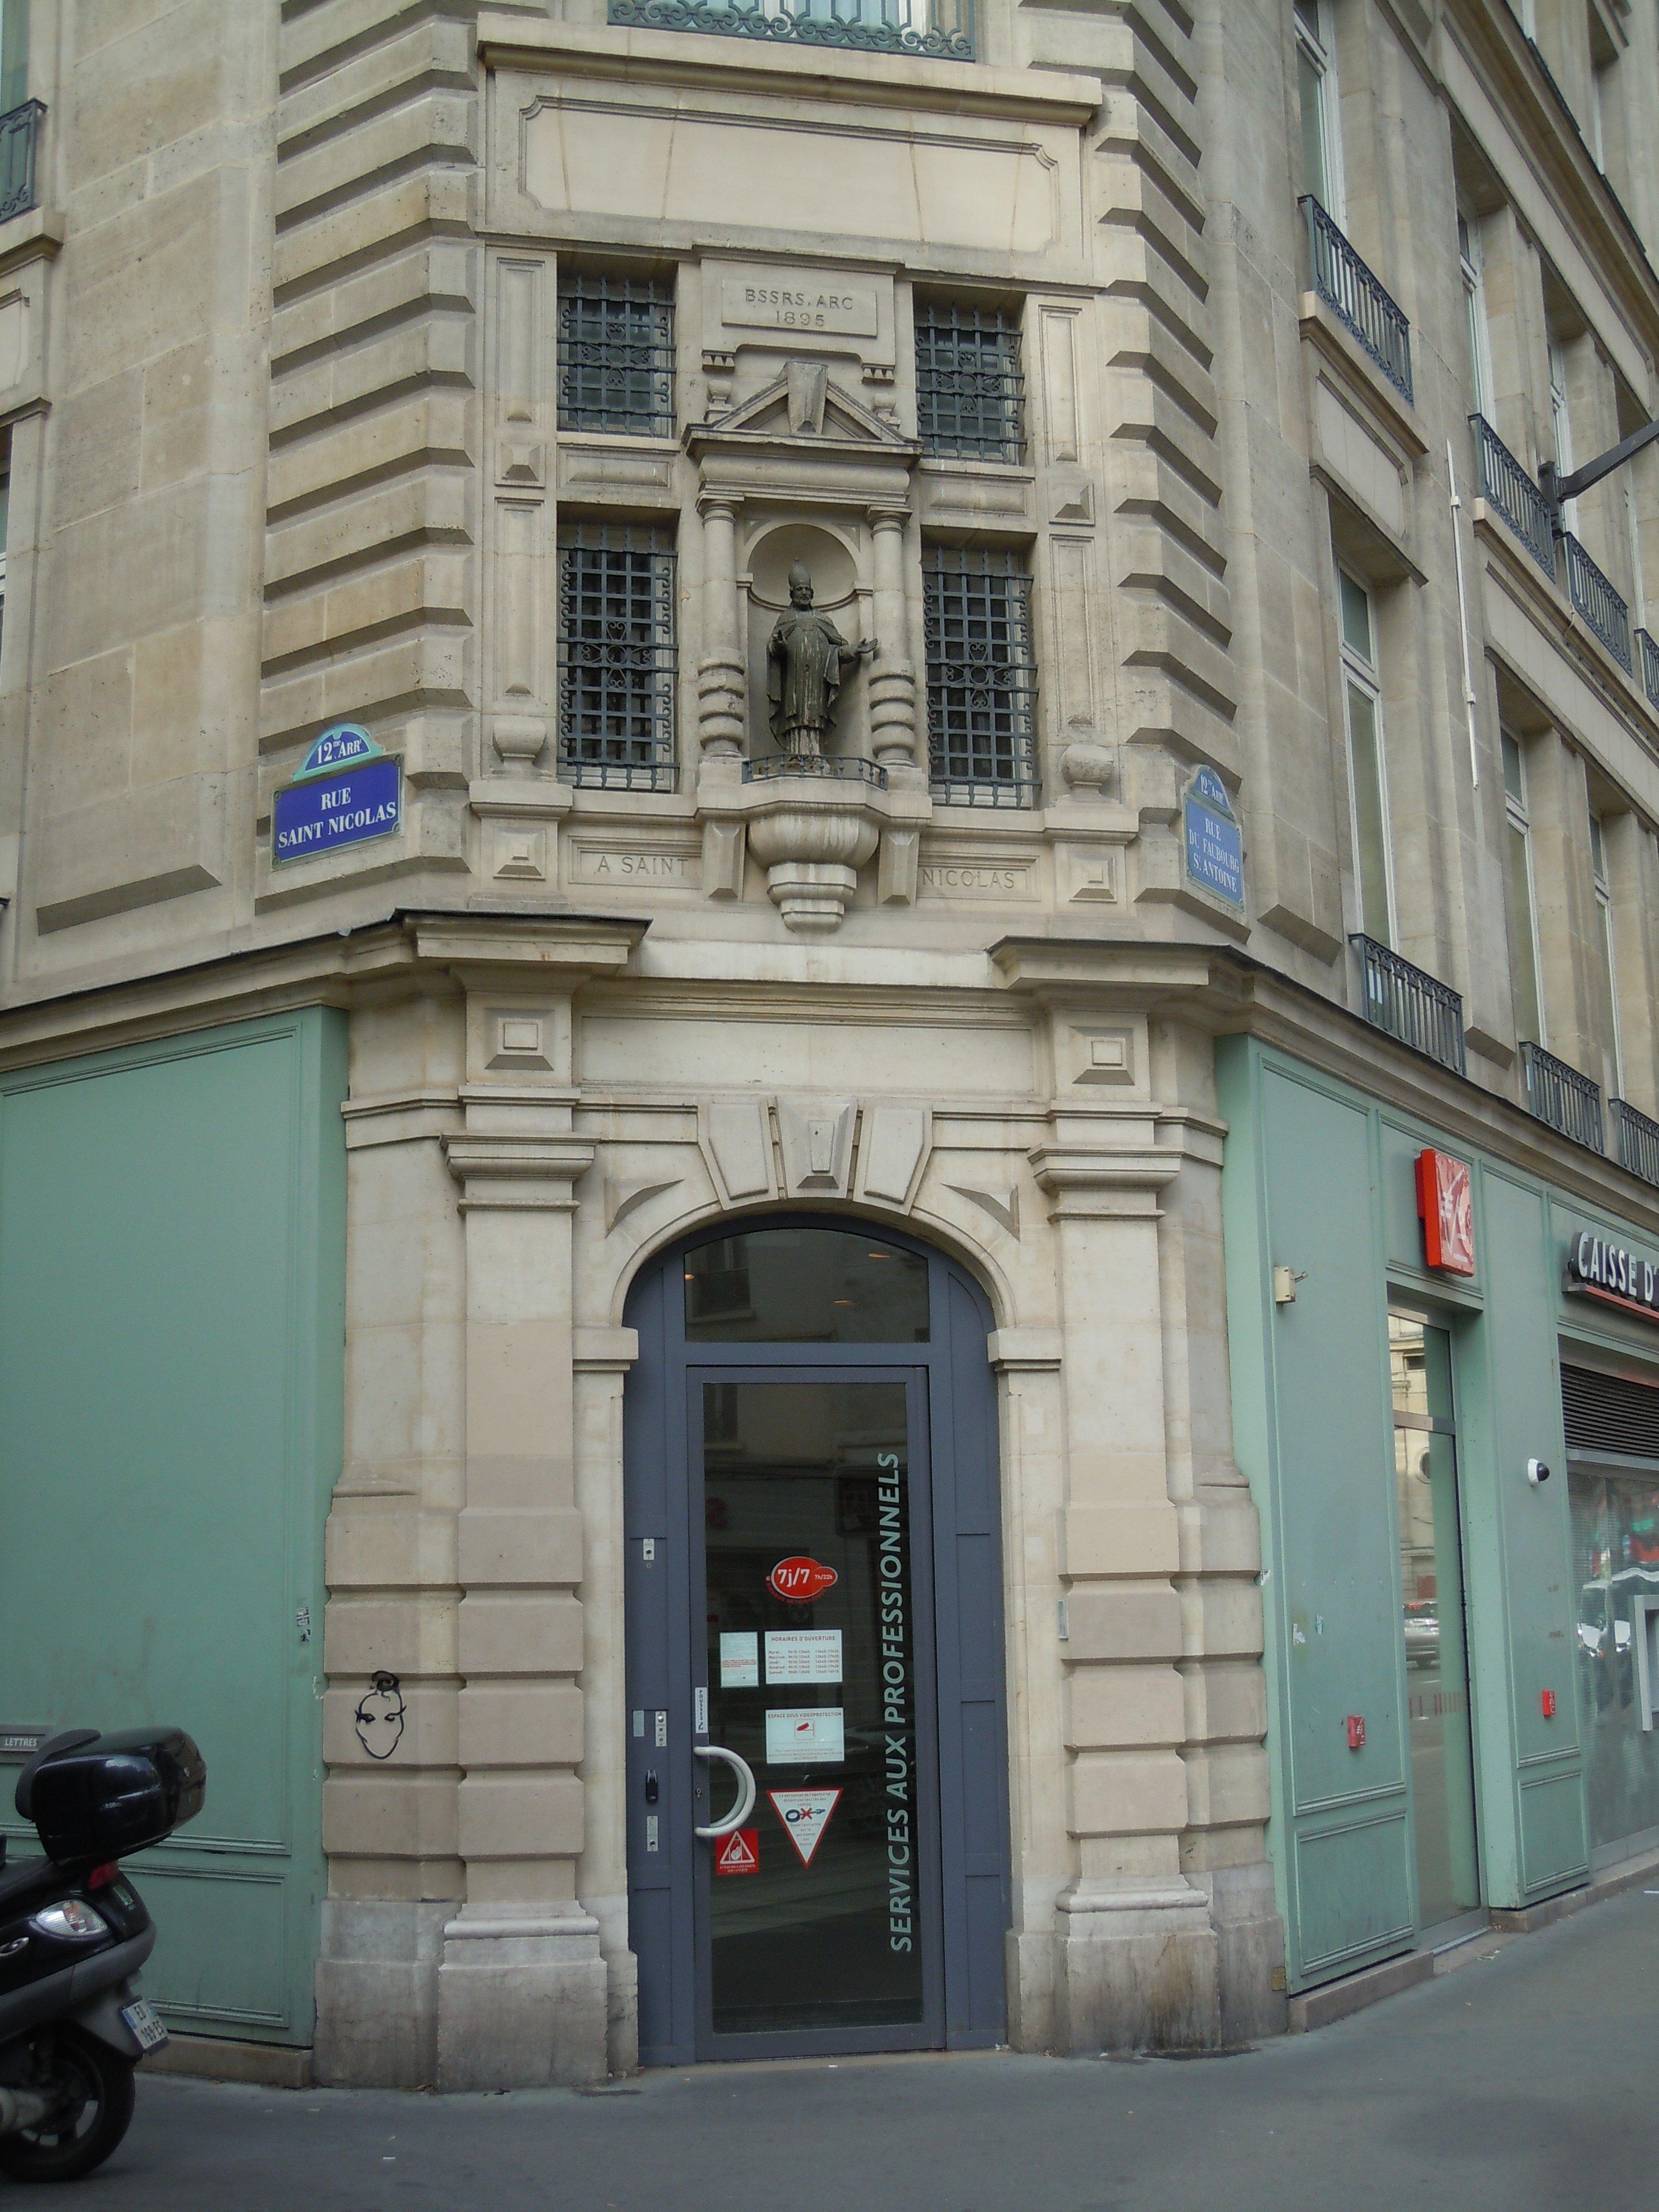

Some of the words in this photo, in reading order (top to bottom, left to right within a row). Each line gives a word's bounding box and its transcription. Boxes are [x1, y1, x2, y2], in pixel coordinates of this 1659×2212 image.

[776, 310, 825, 327] 1895
[321, 787, 351, 811] RUE
[279, 821, 324, 849] SAINT
[328, 801, 396, 836] NICOLAS
[1205, 818, 1222, 841] RUE
[1189, 828, 1200, 848] DU
[1203, 838, 1240, 874] FAUBOURG
[597, 856, 611, 872] A
[622, 857, 688, 876] SAINT
[923, 869, 1014, 889] NICOLAS
[1202, 859, 1238, 893] ANTOINE
[1573, 1231, 1637, 1297] CAISSE
[777, 1567, 810, 1588] 7j/7
[877, 1453, 906, 1724] PROFESSIONNELS
[5, 1737, 37, 1747] LETTRES
[885, 1734, 908, 1801] AUX
[887, 1808, 912, 1952] SERVICES
